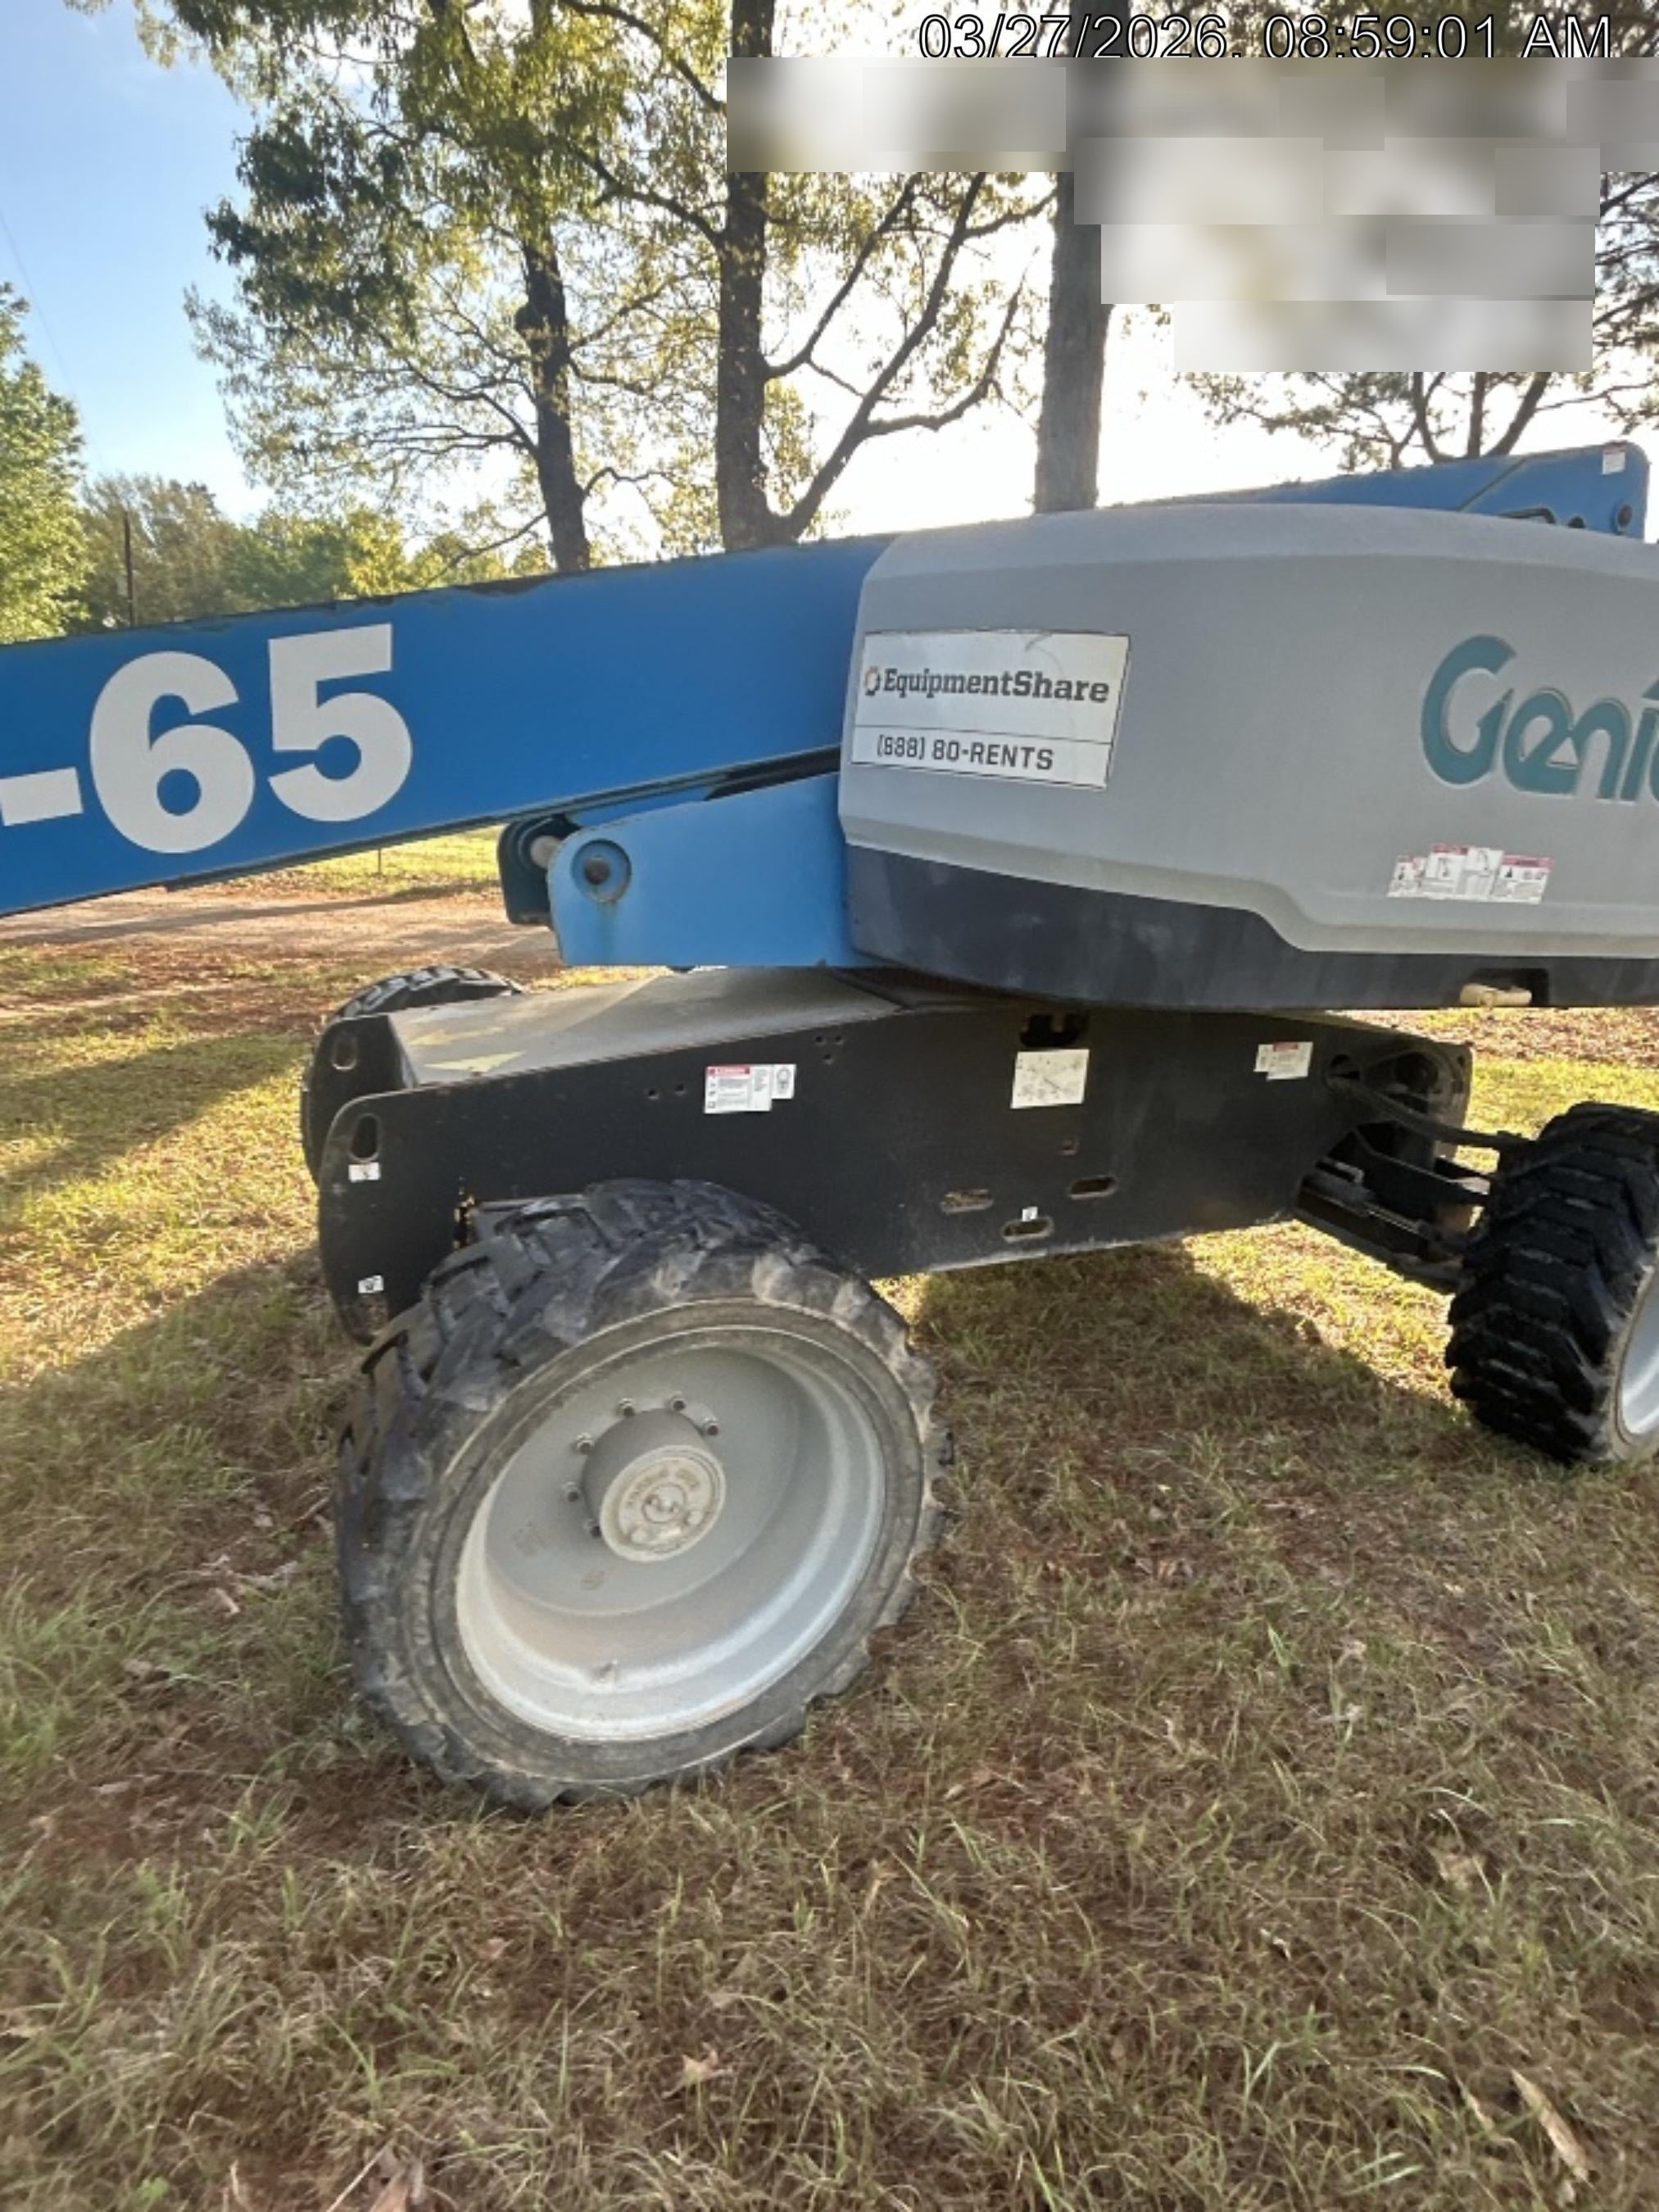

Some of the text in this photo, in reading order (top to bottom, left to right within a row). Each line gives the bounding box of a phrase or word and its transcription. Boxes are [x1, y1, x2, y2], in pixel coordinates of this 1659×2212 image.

[883, 668, 1110, 703] EquipmentShare
[1421, 633, 1659, 802] Geni
[877, 734, 1054, 770] (888) 80-RENTS
